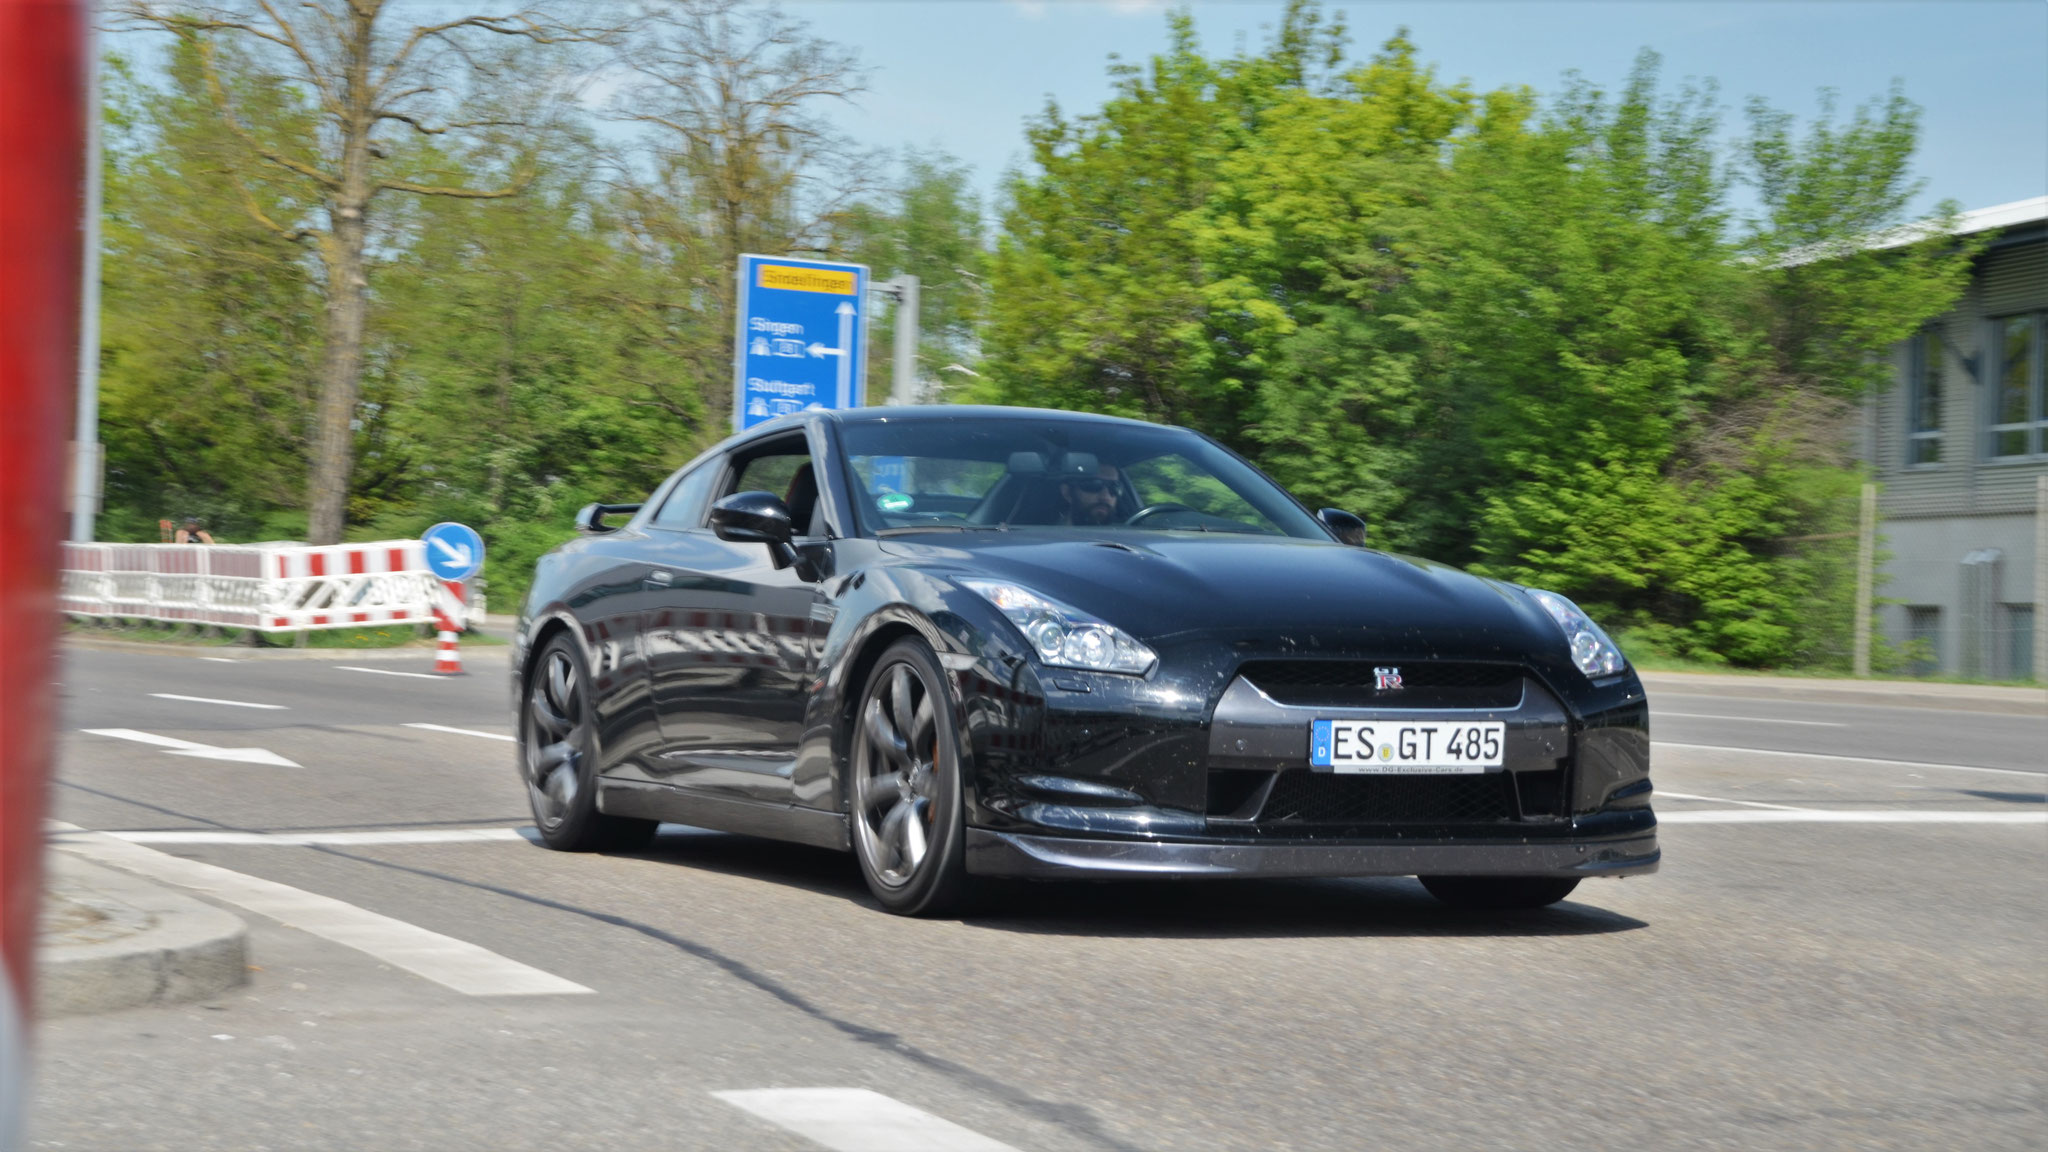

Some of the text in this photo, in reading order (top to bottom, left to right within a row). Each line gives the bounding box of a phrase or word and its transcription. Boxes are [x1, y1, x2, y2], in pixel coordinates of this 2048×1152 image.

[1318, 746, 1326, 758] D
[1333, 727, 1500, 760] ES GT 485
